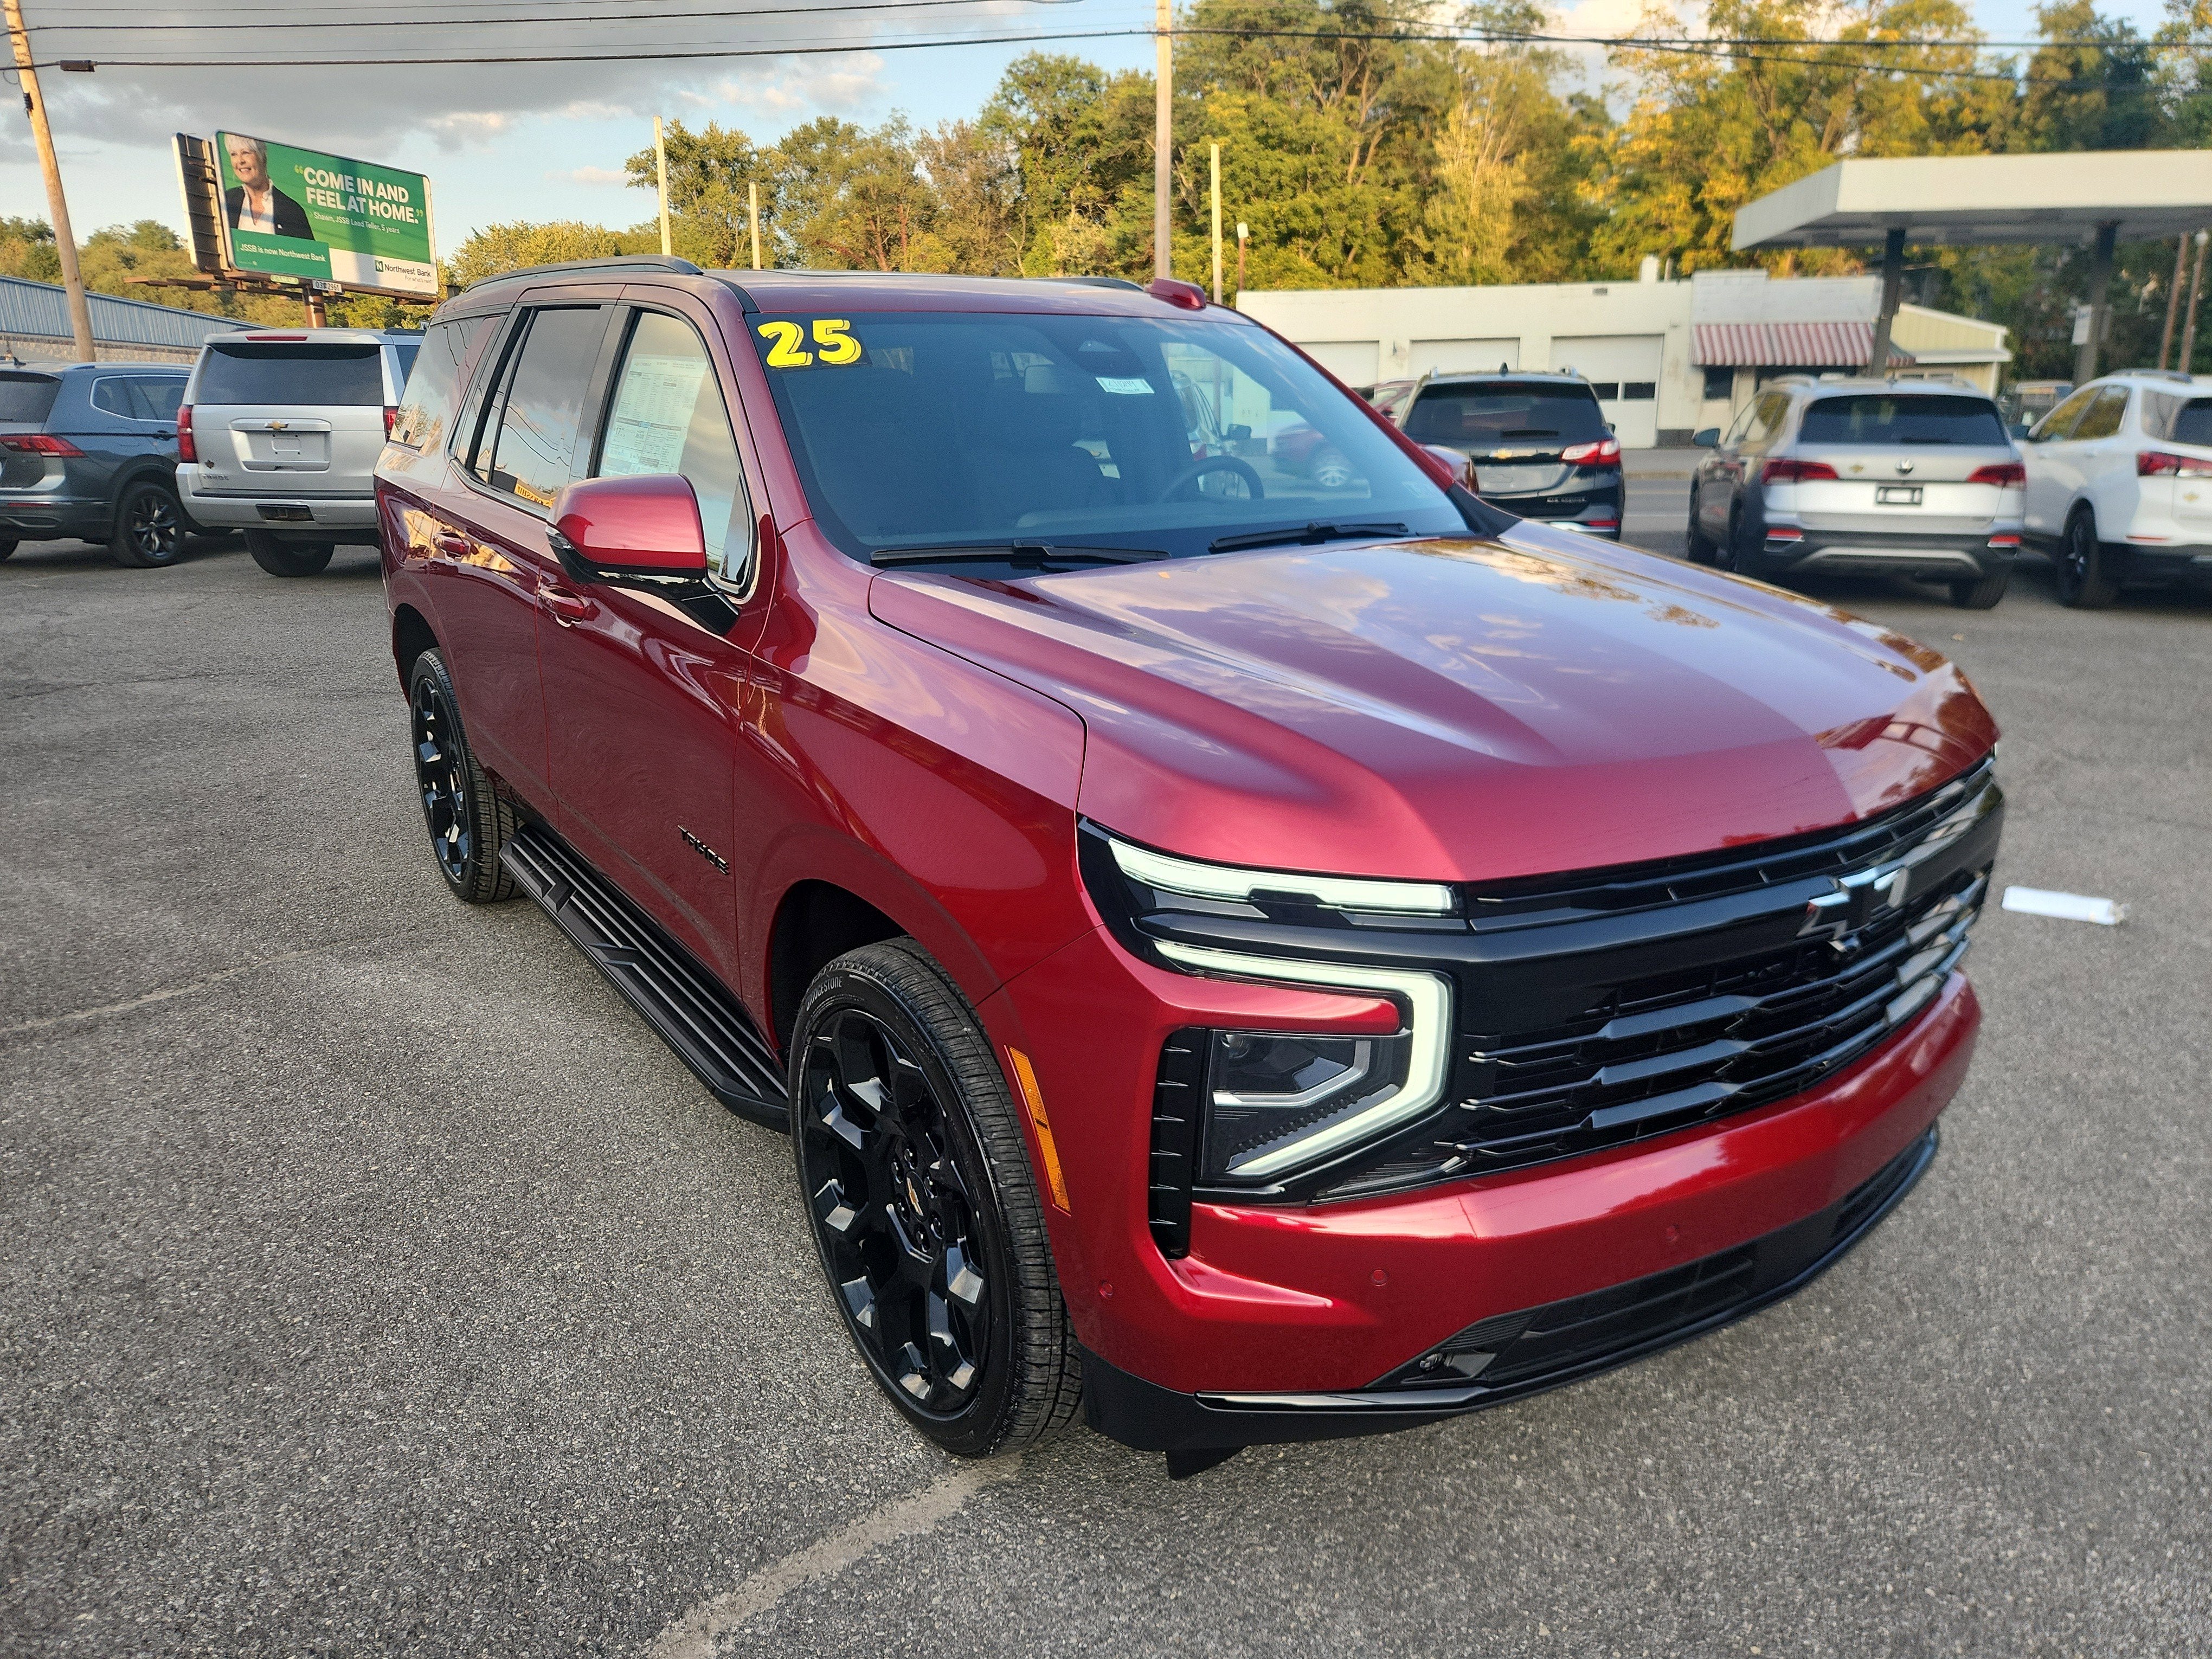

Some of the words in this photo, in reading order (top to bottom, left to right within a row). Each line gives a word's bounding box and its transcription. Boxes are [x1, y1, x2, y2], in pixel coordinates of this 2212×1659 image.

[306, 187, 346, 210] FEEL
[346, 195, 366, 214] AT
[357, 177, 374, 196] IN
[376, 182, 409, 203] AND
[313, 211, 336, 223] Shawn,
[336, 216, 350, 225] JSSB
[351, 218, 364, 227] Lead
[240, 244, 258, 252] JSSB
[278, 249, 311, 260] Northwest
[311, 253, 326, 262] Bank
[384, 263, 416, 275] Northwest
[417, 269, 432, 278] Bank
[757, 319, 862, 368] 25
[678, 824, 730, 876] TAHOE
